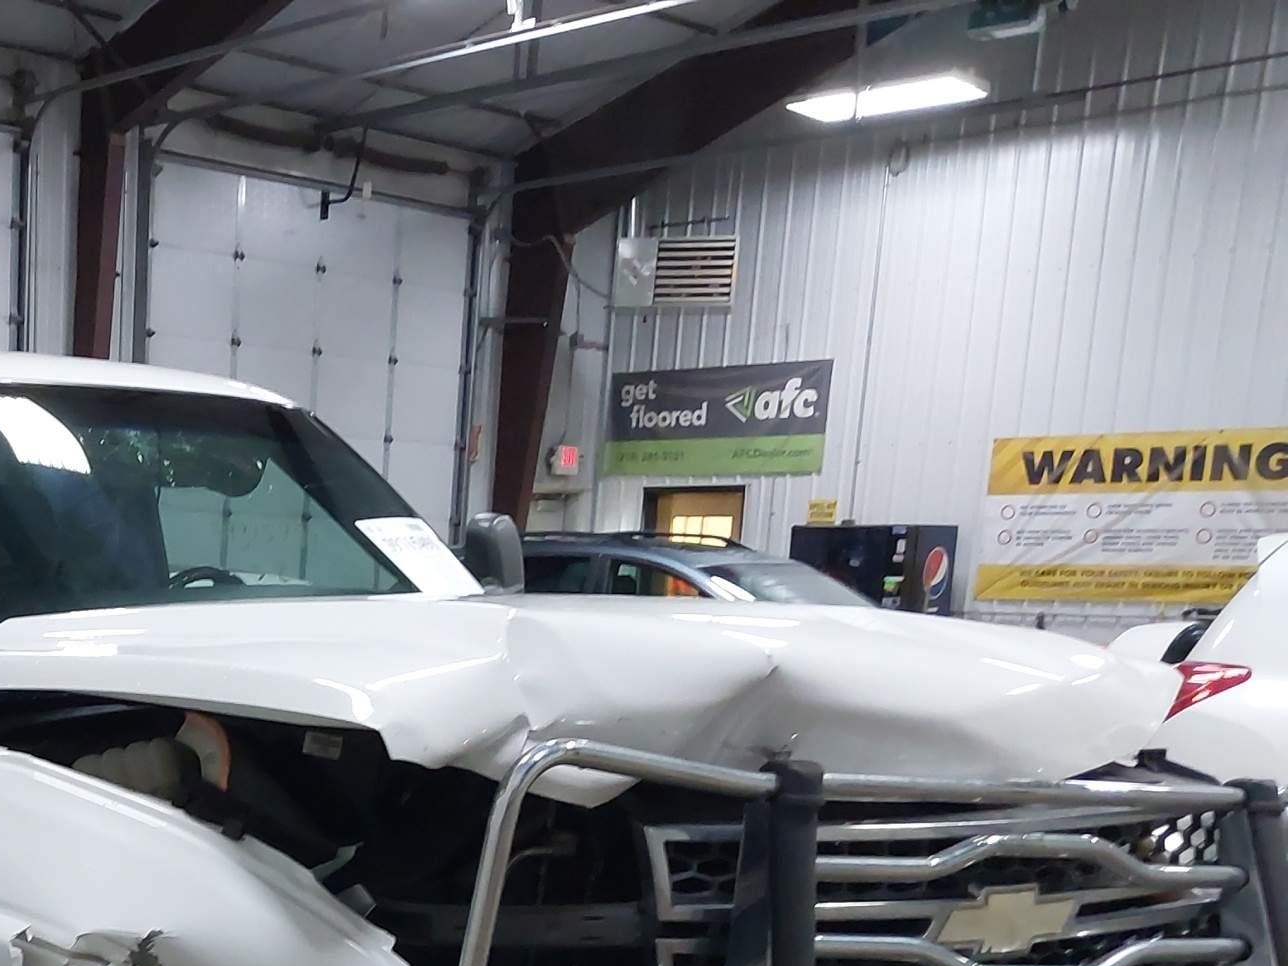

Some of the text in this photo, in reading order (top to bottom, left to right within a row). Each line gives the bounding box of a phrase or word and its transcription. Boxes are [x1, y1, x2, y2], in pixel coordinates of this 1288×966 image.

[621, 380, 657, 407] get
[754, 377, 818, 420] afc
[630, 402, 708, 429] floored
[1022, 442, 1288, 485] WARNING
